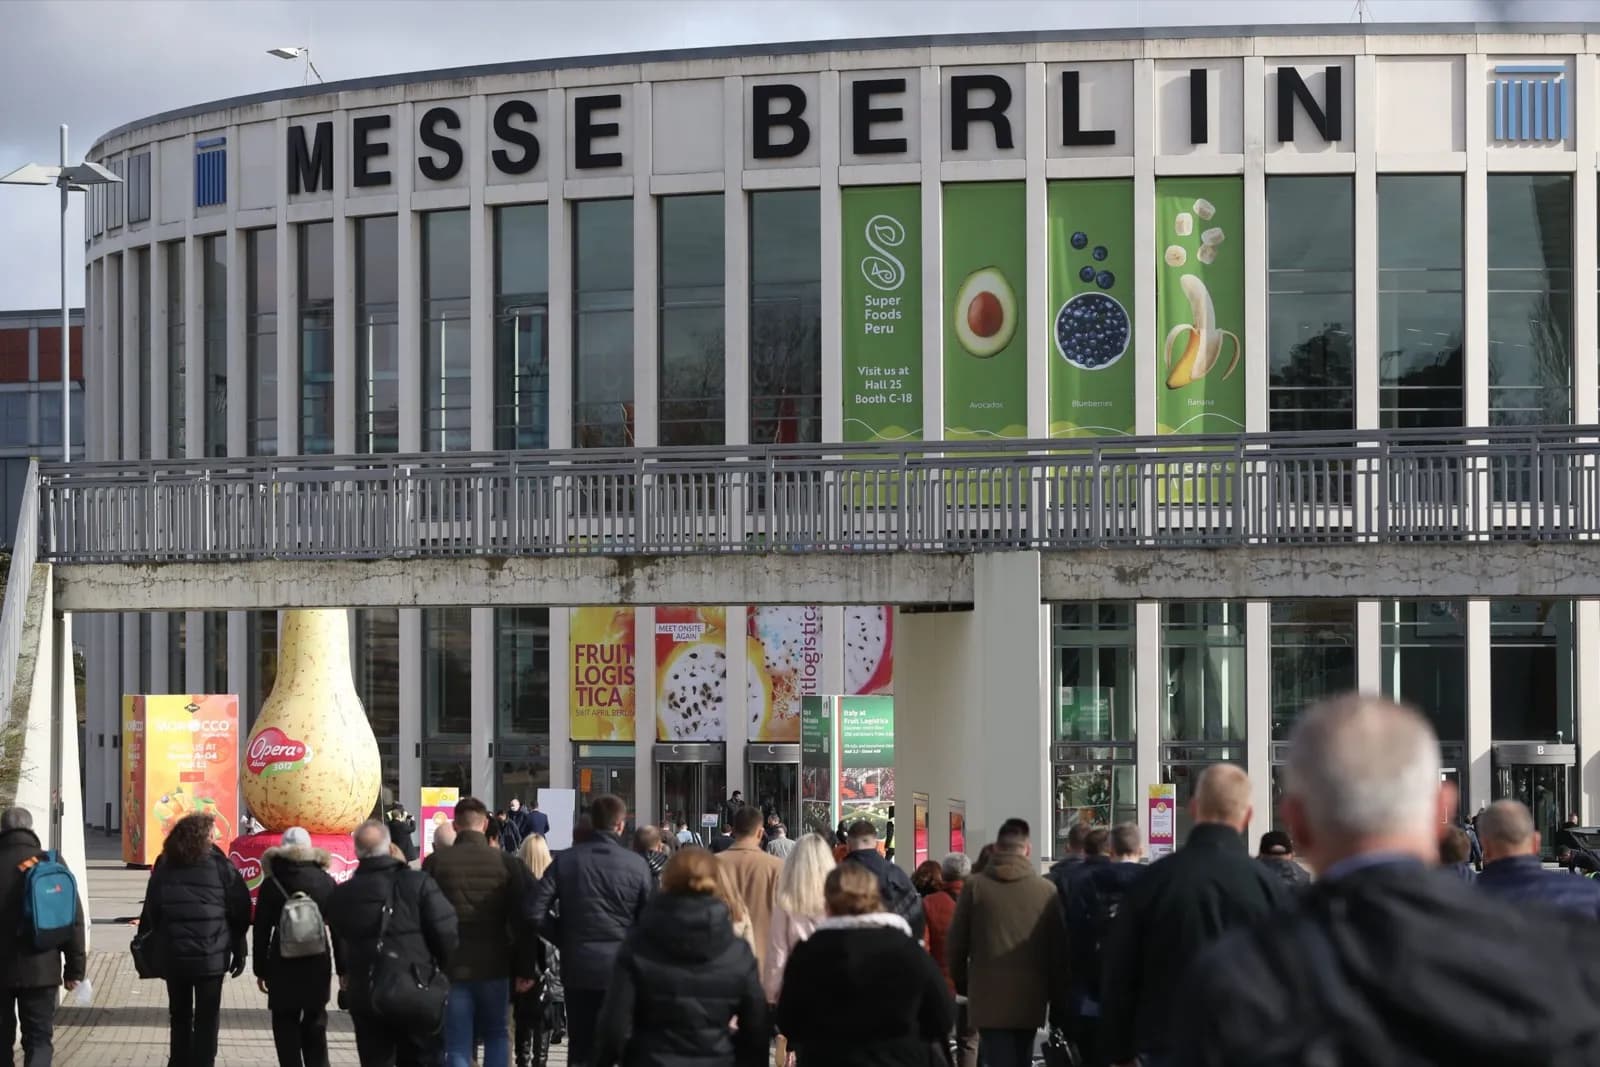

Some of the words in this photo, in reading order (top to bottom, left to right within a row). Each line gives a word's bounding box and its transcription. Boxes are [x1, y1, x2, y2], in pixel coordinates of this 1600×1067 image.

[288, 94, 623, 195] MESSE
[753, 66, 1341, 159] BERLIN
[865, 295, 901, 308] Super
[865, 309, 902, 320] Foods
[865, 323, 894, 334] Peru
[857, 366, 881, 376] Visit
[884, 368, 896, 376] us
[898, 366, 909, 375] at
[865, 380, 887, 390] Hall
[889, 380, 902, 390] 25
[855, 394, 886, 404] Booth
[888, 393, 913, 404] C-18
[658, 625, 677, 633] MEET
[678, 625, 703, 633] ONSITE
[575, 644, 635, 664] FRUIT
[575, 665, 635, 685] LOGIS
[575, 686, 623, 707] TICA
[251, 737, 297, 760] Opera
